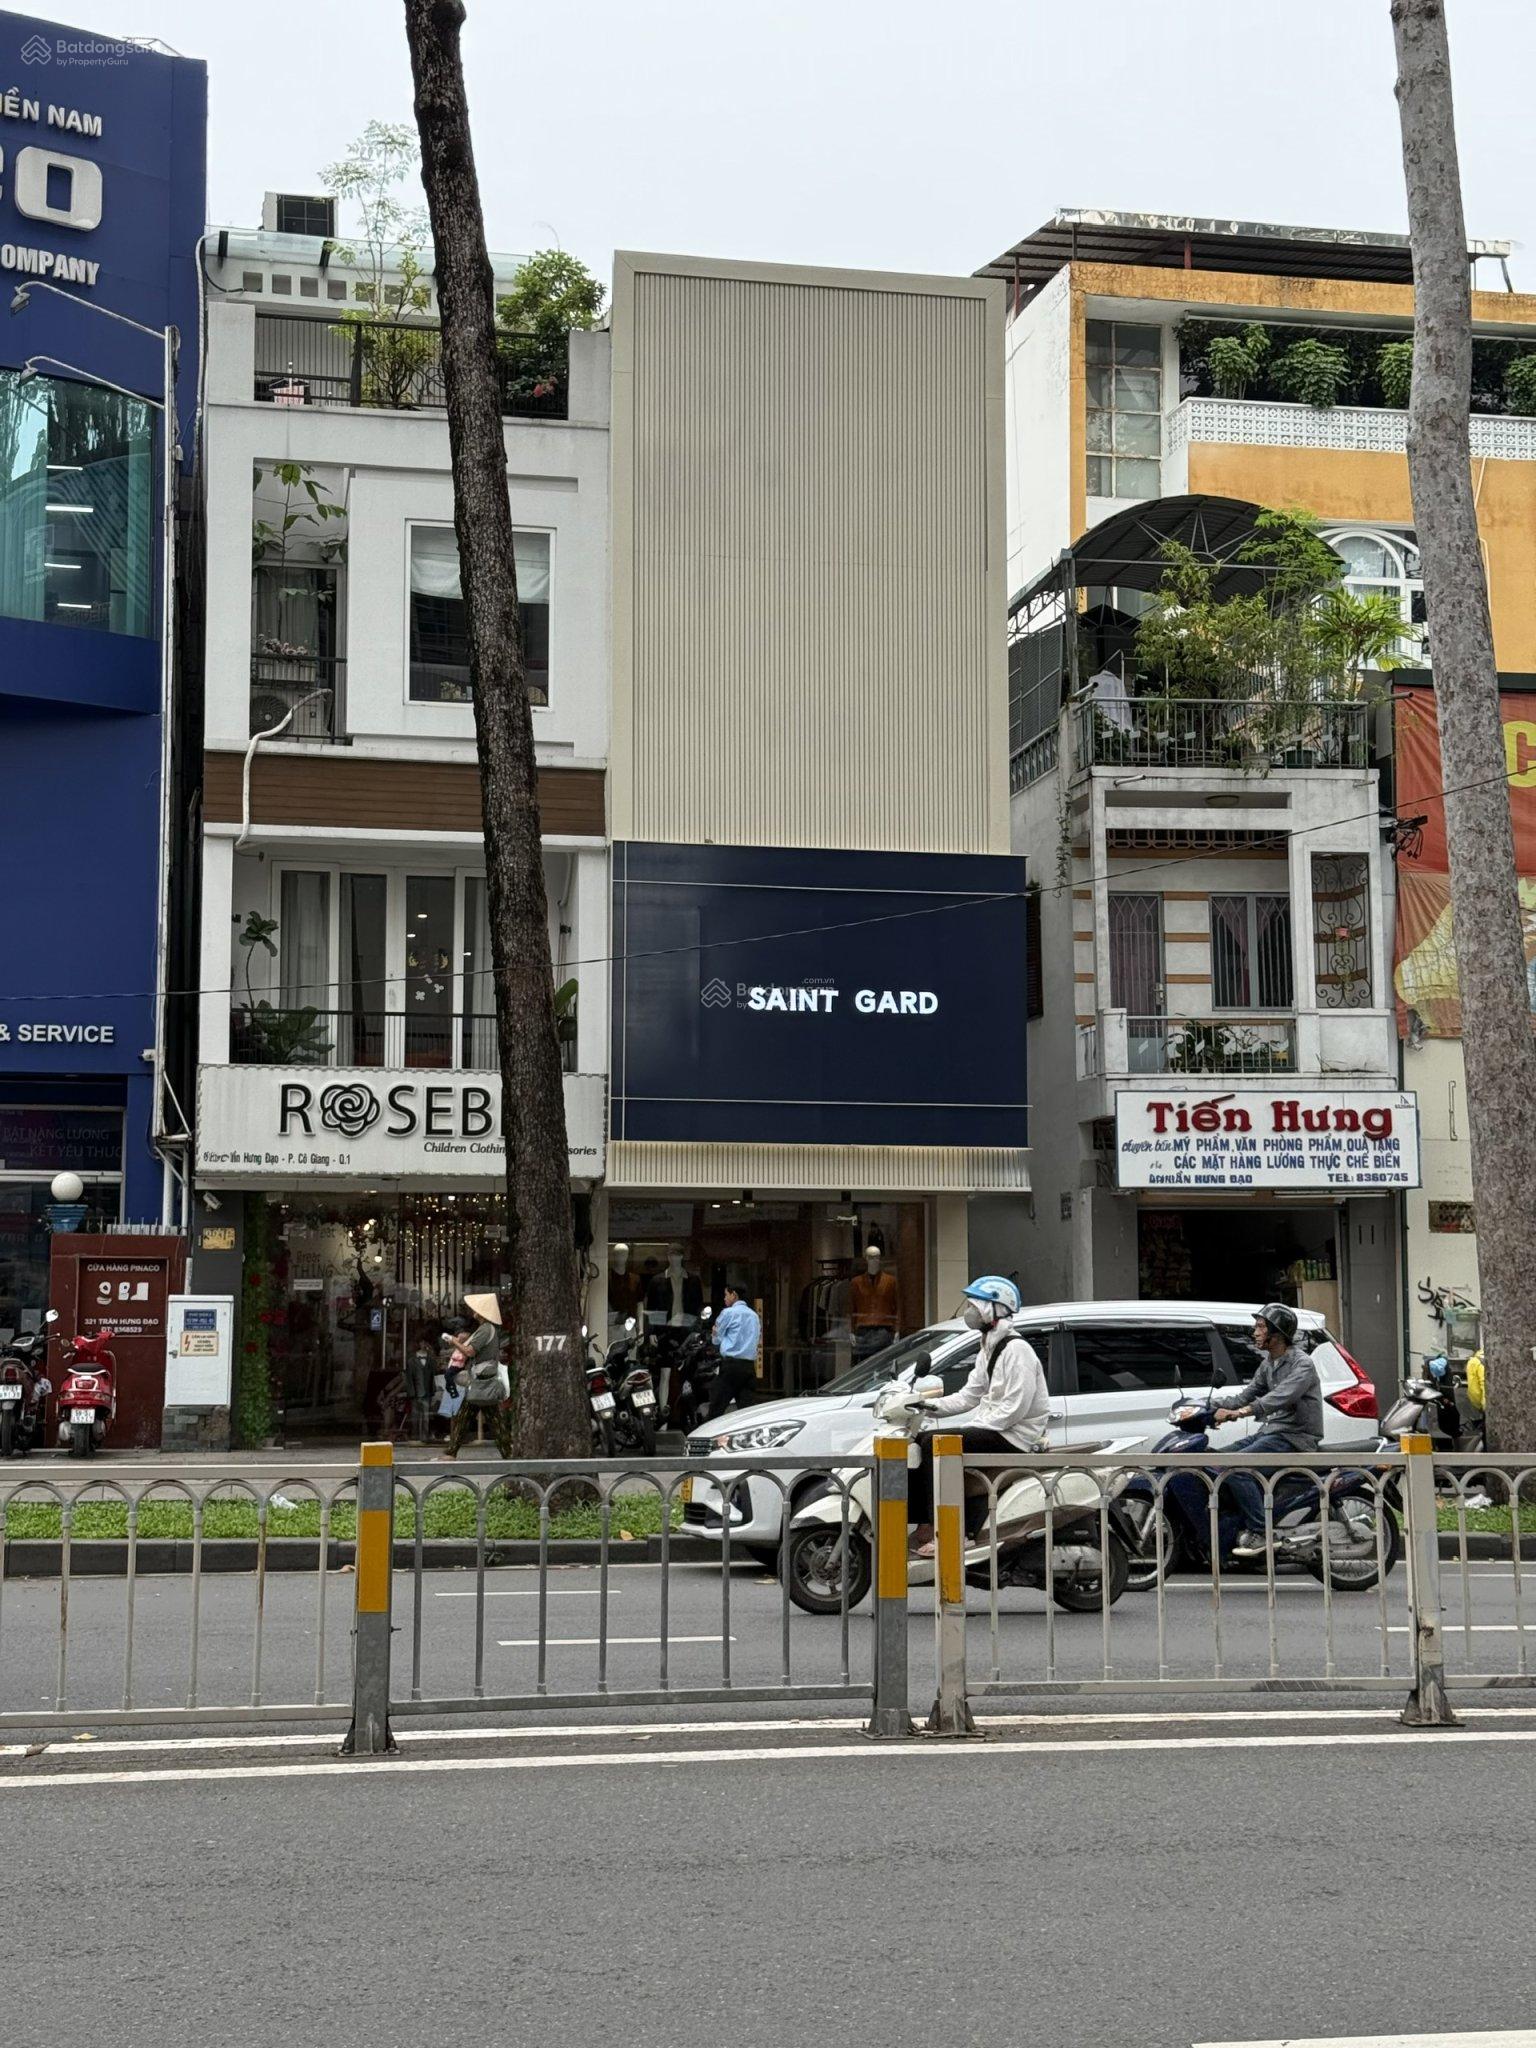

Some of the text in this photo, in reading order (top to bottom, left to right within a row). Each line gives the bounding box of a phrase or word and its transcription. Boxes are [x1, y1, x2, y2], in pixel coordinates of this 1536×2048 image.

[47, 104, 103, 137] NAM
[0, 145, 103, 232] O
[747, 986, 939, 1015] SAINT GARD
[18, 1024, 115, 1044] SERVICE
[1146, 1093, 1394, 1140] Tiến Hưng
[423, 1141, 467, 1153] Children
[1263, 1134, 1303, 1152] PHÒNG
[310, 1153, 330, 1166] Giang
[1173, 1152, 1197, 1169] CÁC
[1201, 1153, 1226, 1171] MẶT
[1230, 1152, 1262, 1170] HÀNG
[1309, 1152, 1341, 1171] THỰC
[1356, 1173, 1409, 1183] 8360745
[130, 1264, 160, 1273] PINACO
[535, 1335, 567, 1351] 177
